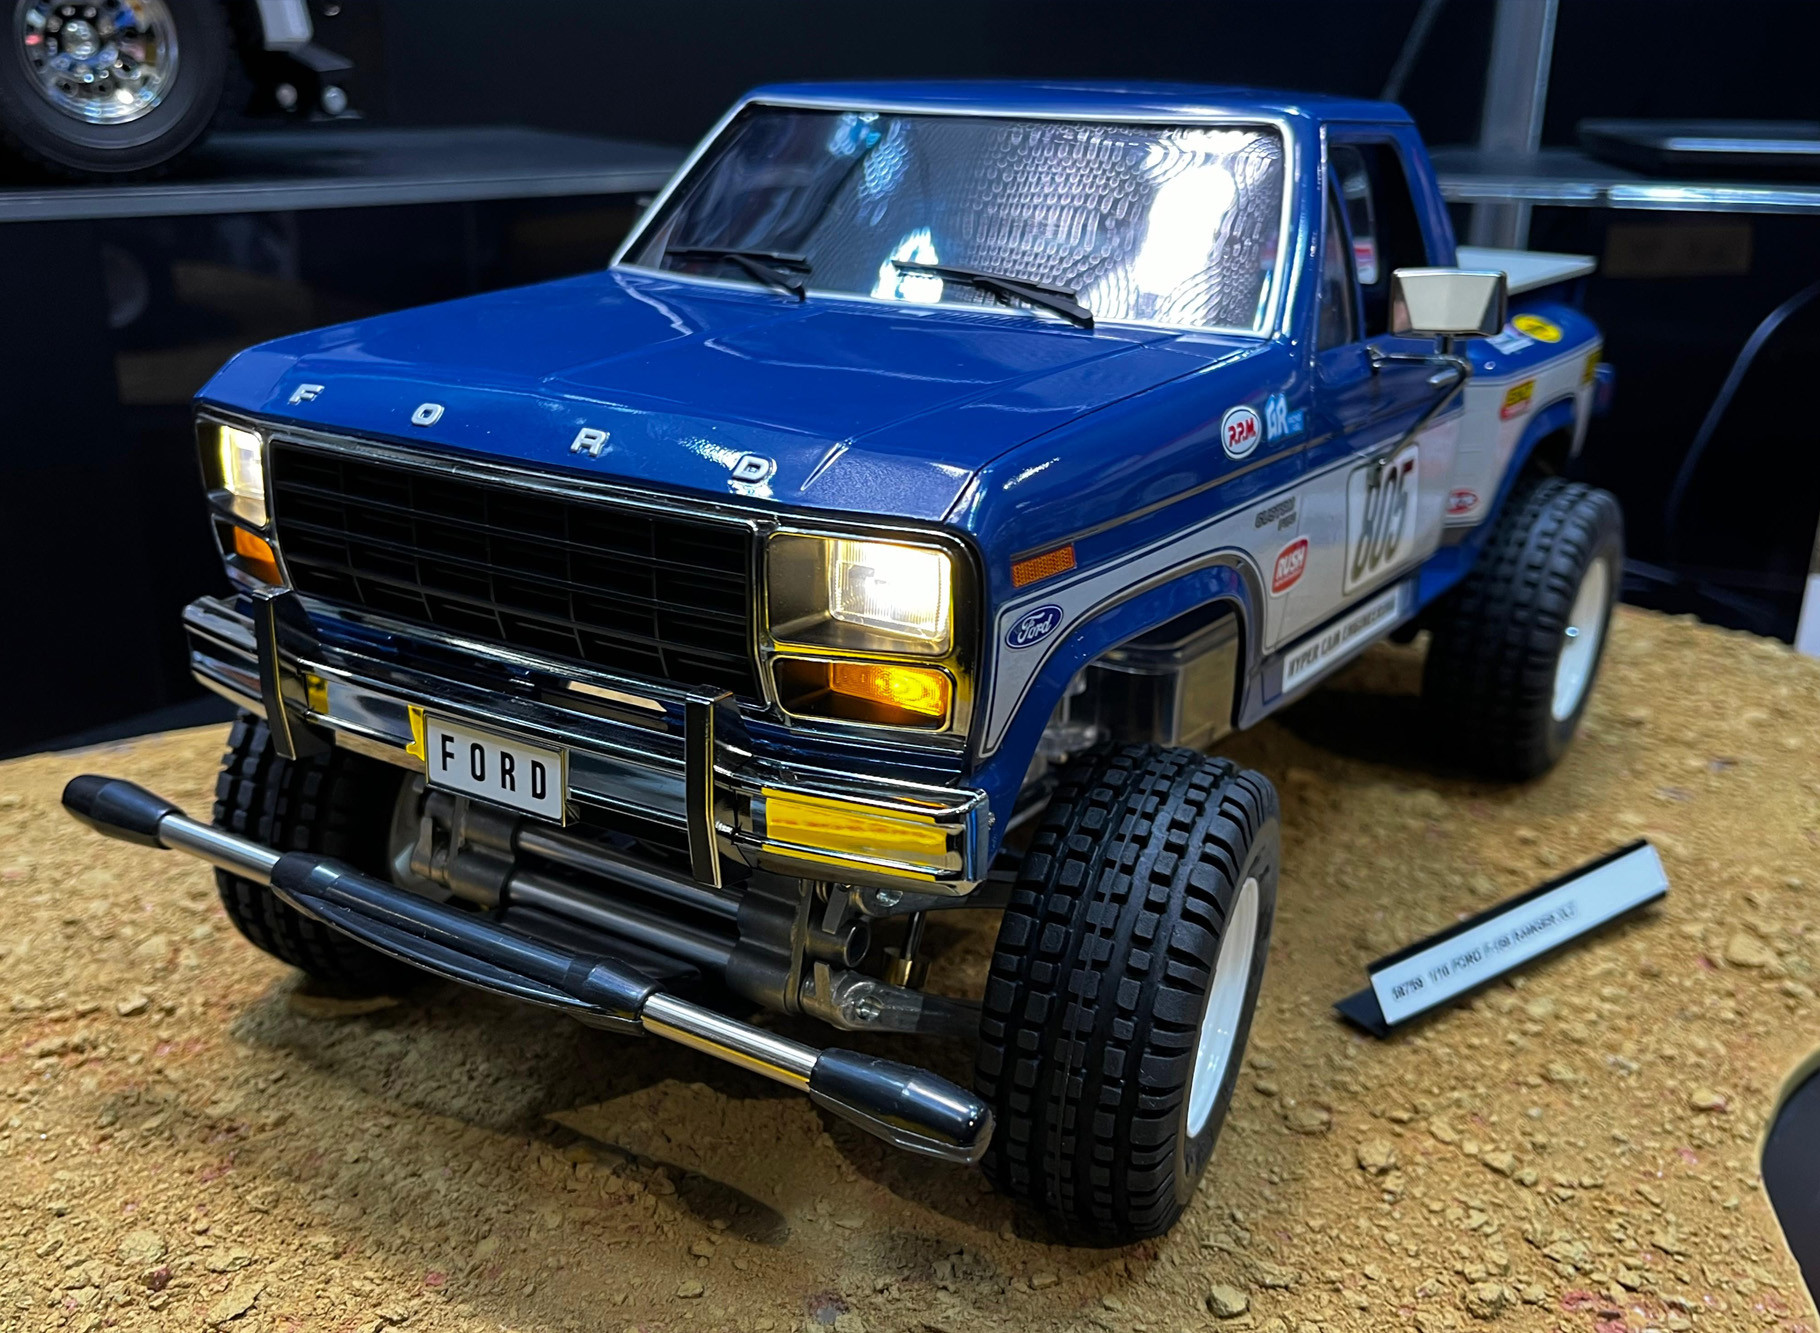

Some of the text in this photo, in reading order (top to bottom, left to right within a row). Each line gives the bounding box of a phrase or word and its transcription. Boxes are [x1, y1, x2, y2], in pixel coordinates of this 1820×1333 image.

[289, 384, 777, 484] FORD
[1017, 612, 1053, 643] Ford
[441, 733, 547, 801] FORD
